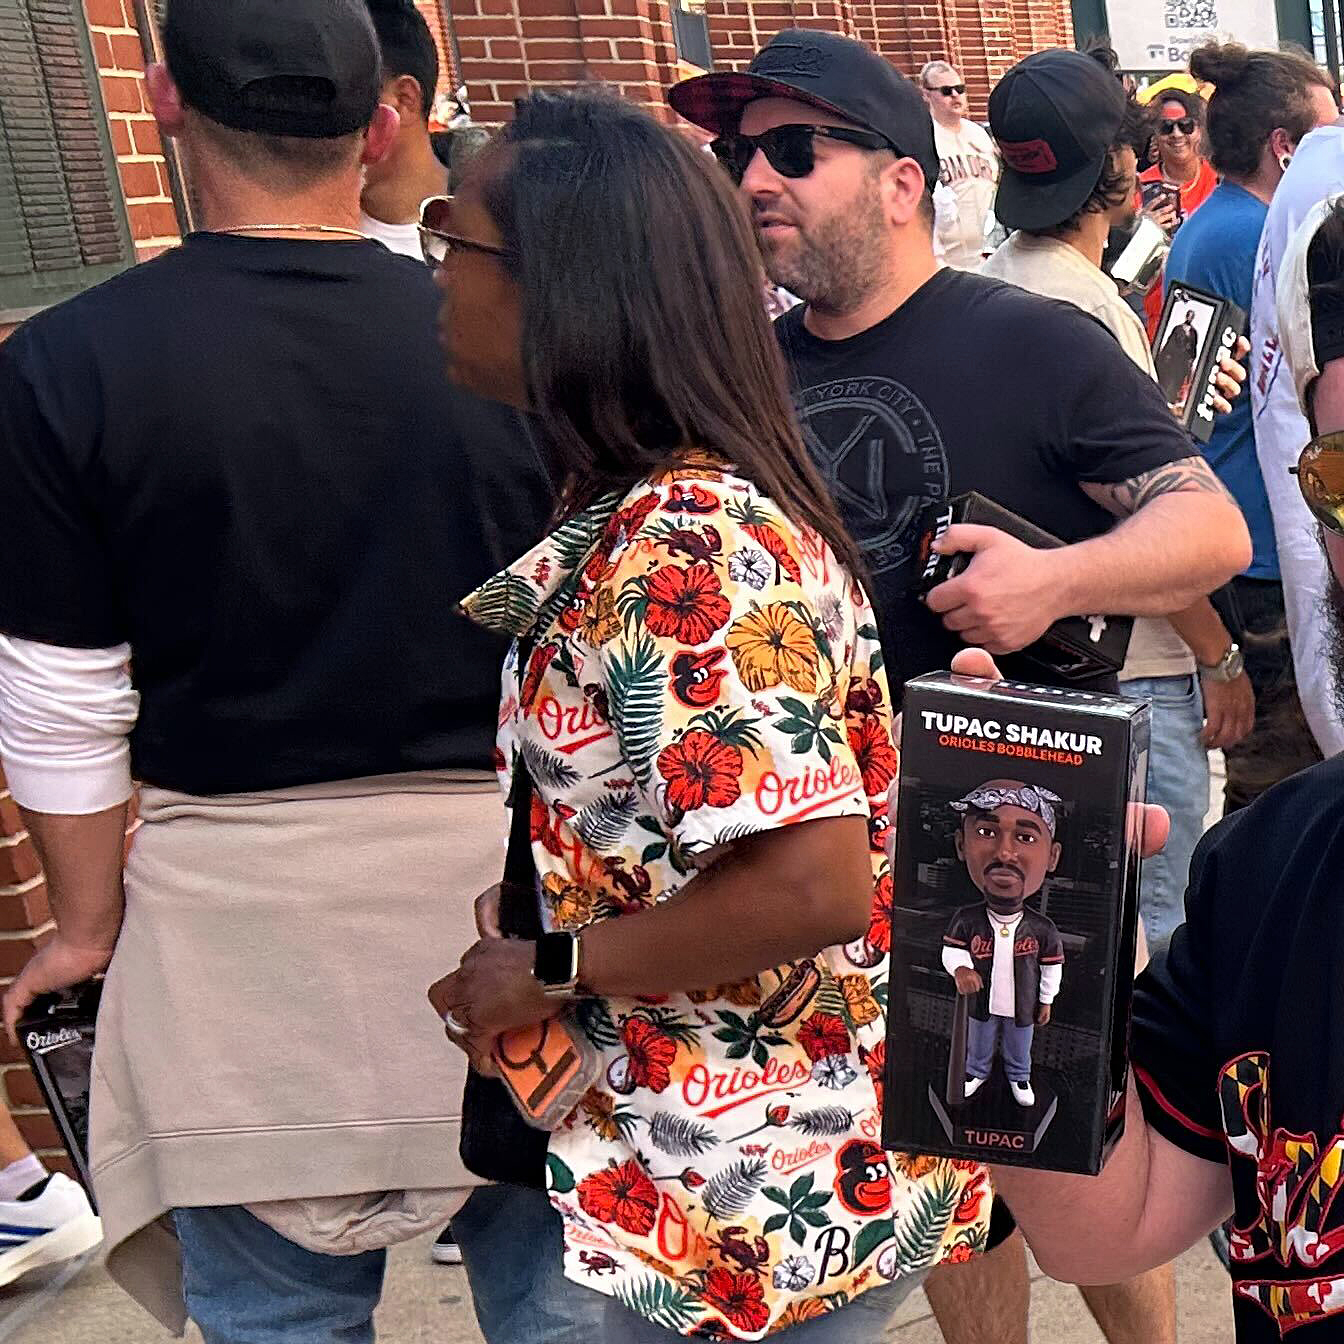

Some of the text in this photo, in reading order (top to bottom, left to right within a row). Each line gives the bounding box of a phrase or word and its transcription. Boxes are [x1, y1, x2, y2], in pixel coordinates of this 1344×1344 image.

[815, 381, 918, 416] YORK CITY
[917, 431, 943, 474] THE
[920, 710, 1103, 755] TUPAC SHAKUR
[937, 733, 1085, 767] ORIOLES BOBBLEHEAD
[755, 755, 862, 816] Orioles
[682, 1057, 811, 1107] Orioles
[771, 1140, 832, 1171] Orioles
[964, 1129, 1025, 1149] TUPAC
